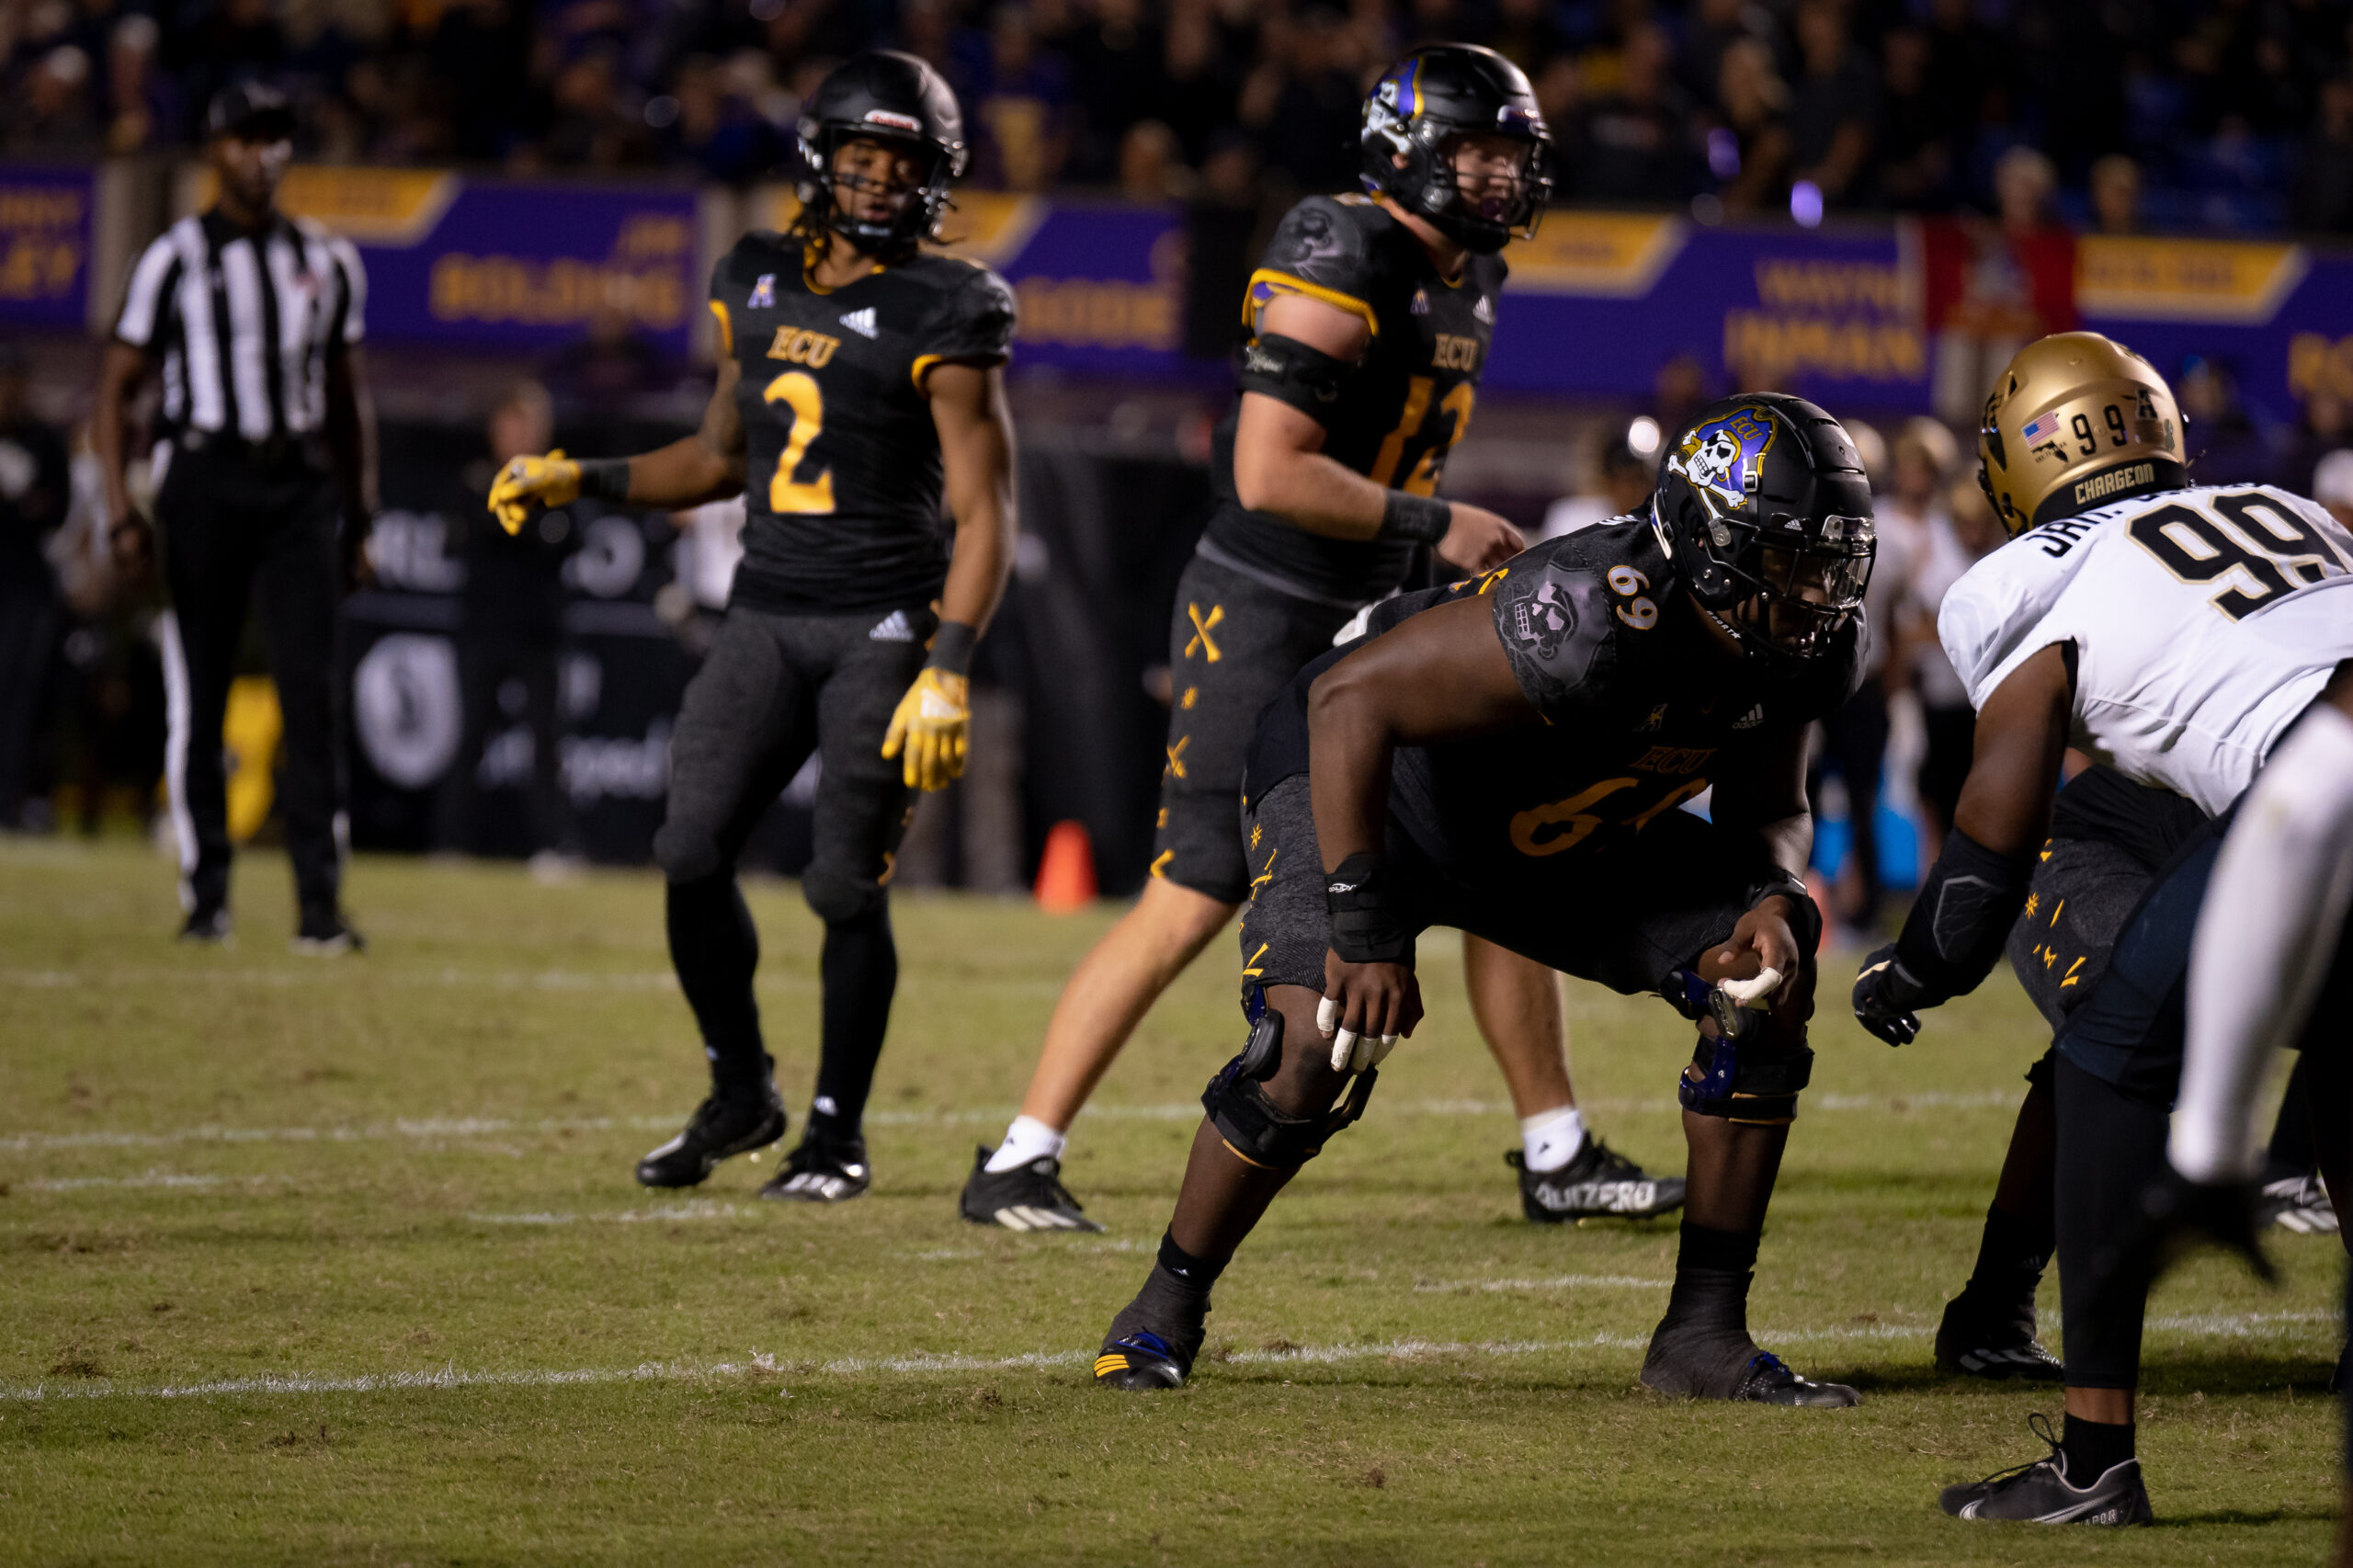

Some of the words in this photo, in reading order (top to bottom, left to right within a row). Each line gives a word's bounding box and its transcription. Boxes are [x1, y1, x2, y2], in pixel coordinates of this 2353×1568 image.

[766, 324, 841, 369] ECU
[1430, 333, 1479, 372] ECU
[763, 371, 835, 514] 2
[1729, 415, 1763, 440] ECU
[2071, 404, 2128, 456] 99
[2123, 489, 2349, 625] 99
[1608, 564, 1659, 630] 69
[1629, 745, 1719, 774] ECU
